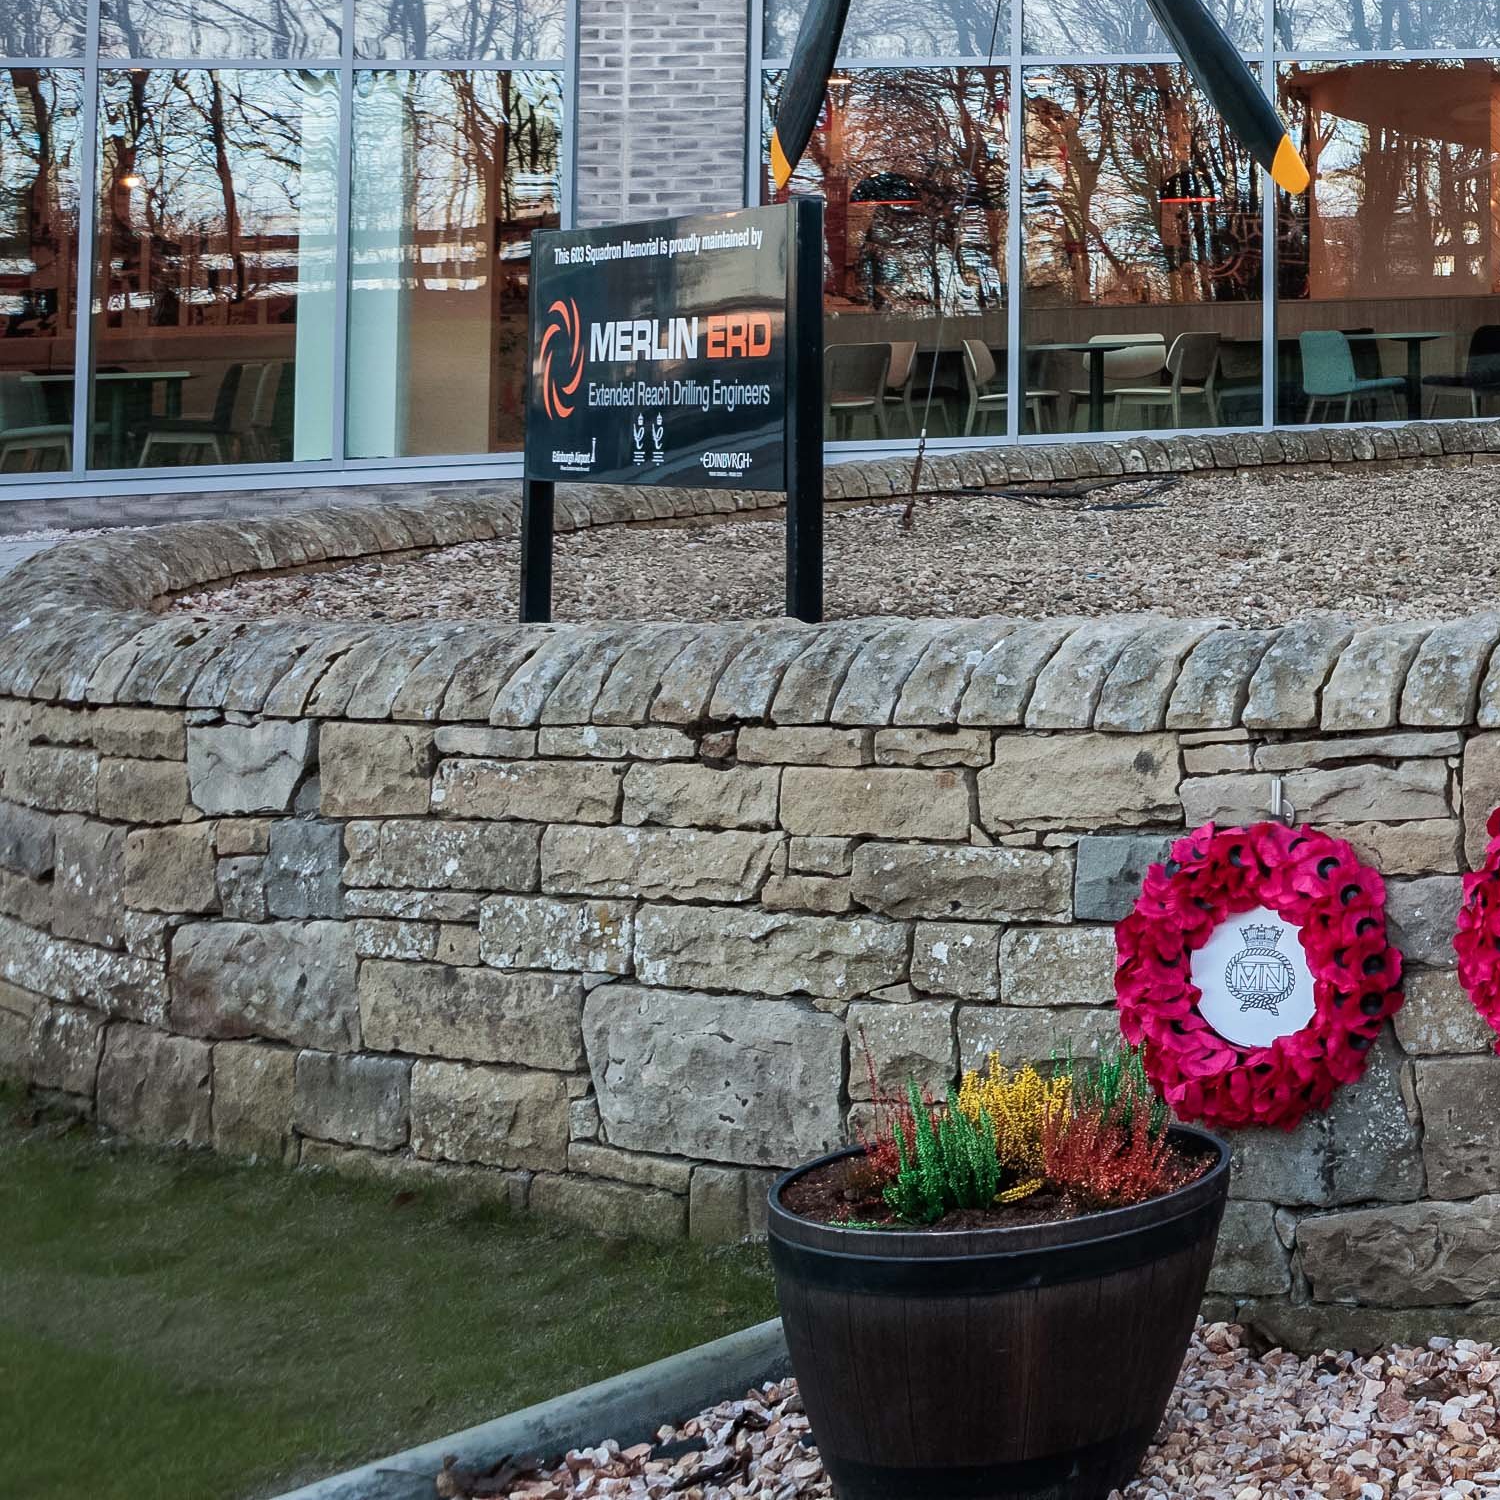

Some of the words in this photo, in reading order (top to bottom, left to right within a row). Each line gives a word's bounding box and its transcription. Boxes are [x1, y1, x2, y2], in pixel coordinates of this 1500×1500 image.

[554, 247, 570, 265] This
[570, 246, 585, 264] 603
[585, 244, 622, 266] Squadron
[622, 237, 659, 258] Memorial
[659, 236, 668, 255] is
[668, 232, 701, 258] proudly
[701, 227, 750, 250] maintained
[751, 226, 763, 250] by
[589, 316, 699, 363] MERLIN
[706, 312, 772, 359] ERD
[588, 381, 636, 406] Extended
[637, 380, 670, 406] Reach
[672, 379, 709, 412] Drilling
[712, 378, 770, 413] Engineers
[1235, 961, 1284, 993] MN
